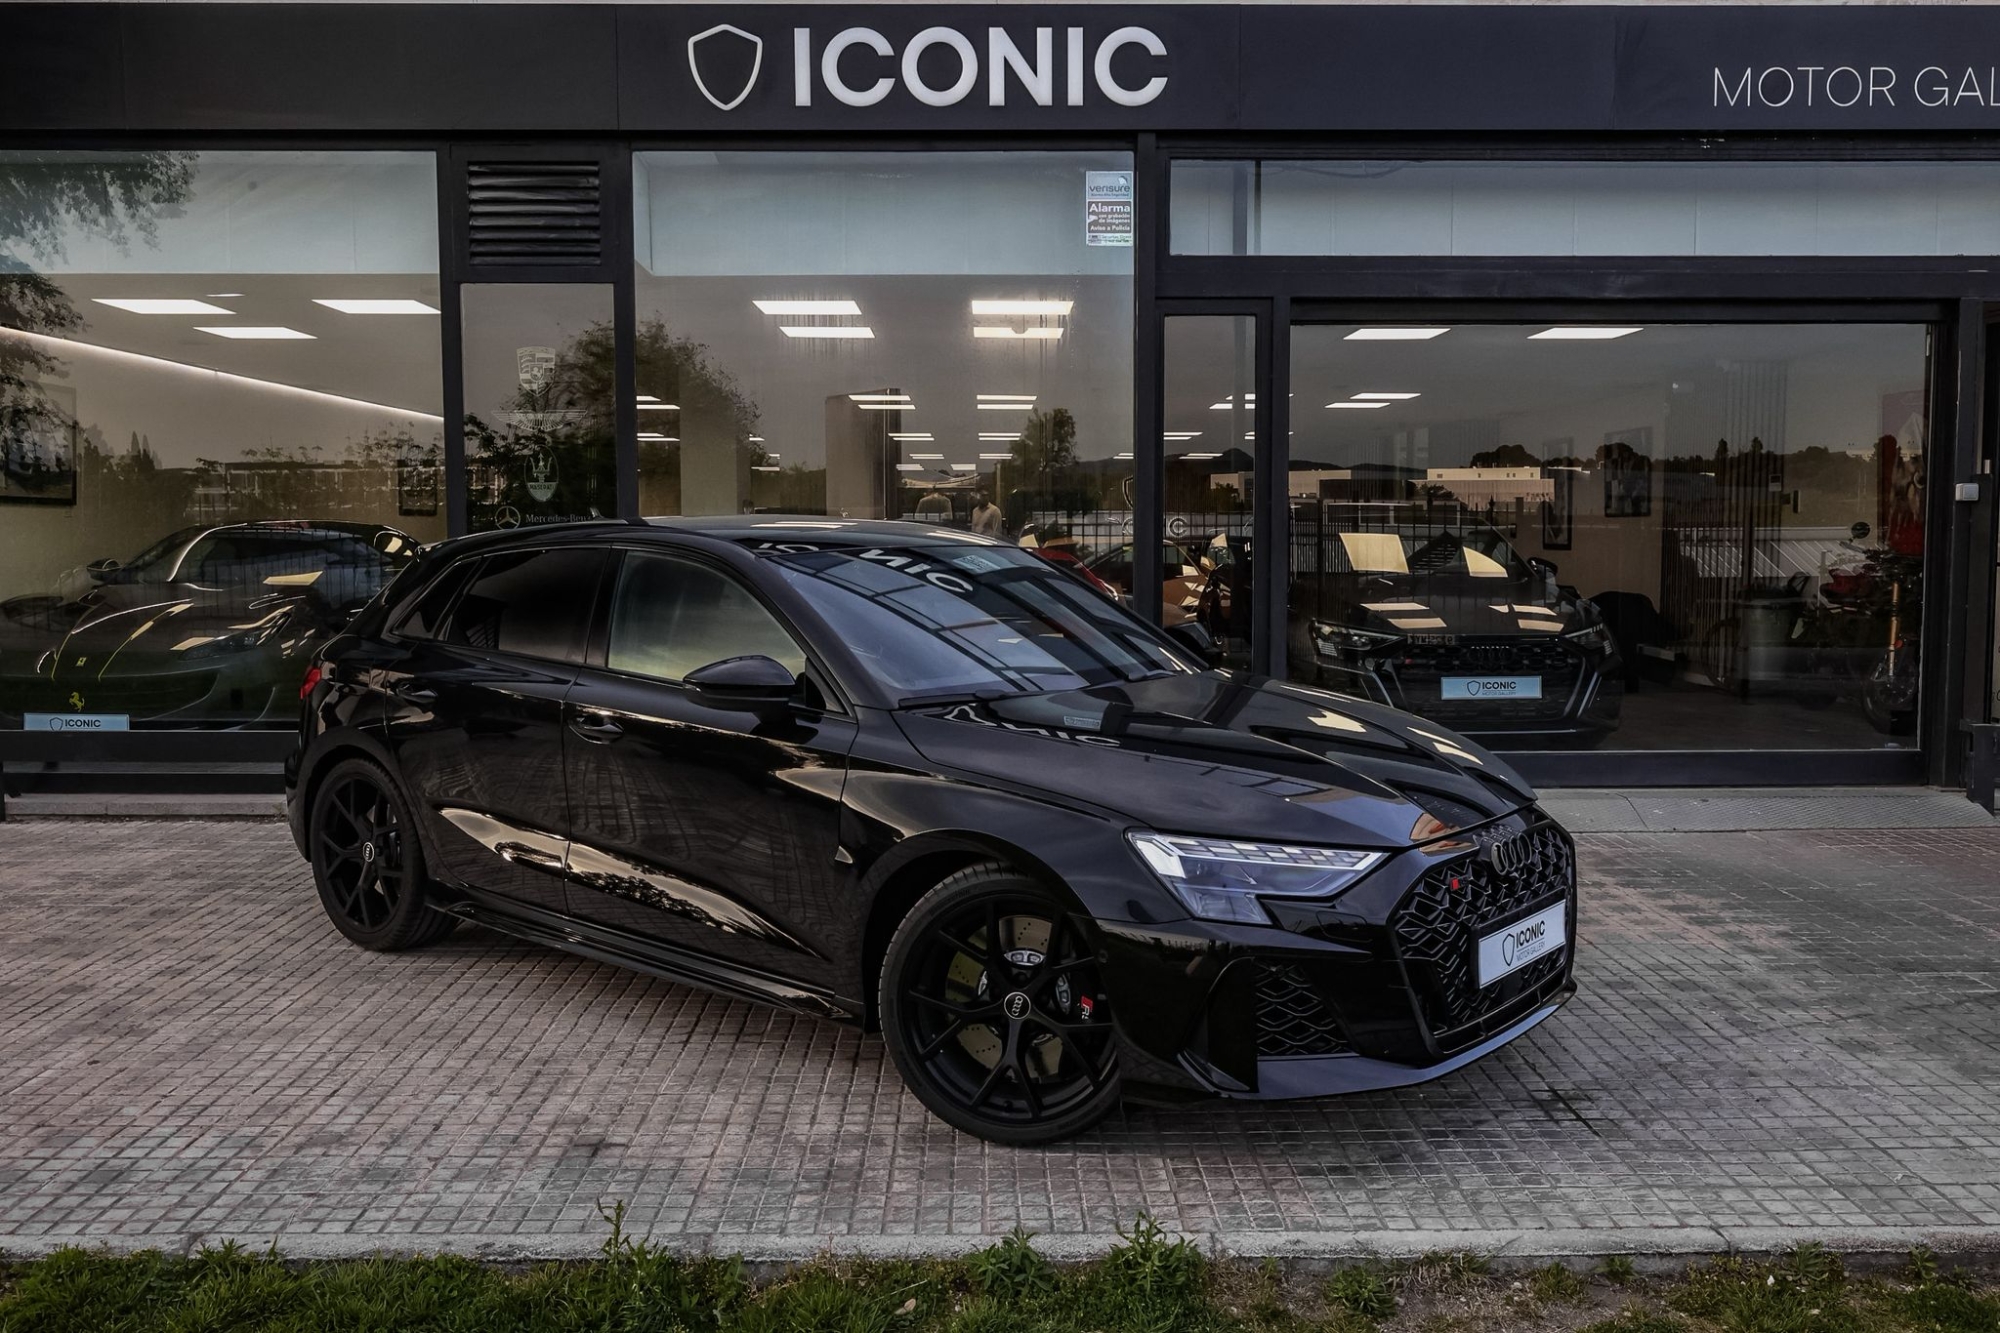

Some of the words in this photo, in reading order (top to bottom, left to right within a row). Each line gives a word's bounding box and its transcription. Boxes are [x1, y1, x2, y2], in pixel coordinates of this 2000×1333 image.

[793, 26, 1169, 107] ICONIC
[1713, 66, 1896, 107] MOTOR
[1913, 66, 2000, 107] GAL
[1089, 203, 1131, 212] Alarma
[1482, 681, 1517, 690] ICONIC
[65, 719, 101, 728] ICONIC
[1516, 920, 1545, 949] ICONIC
